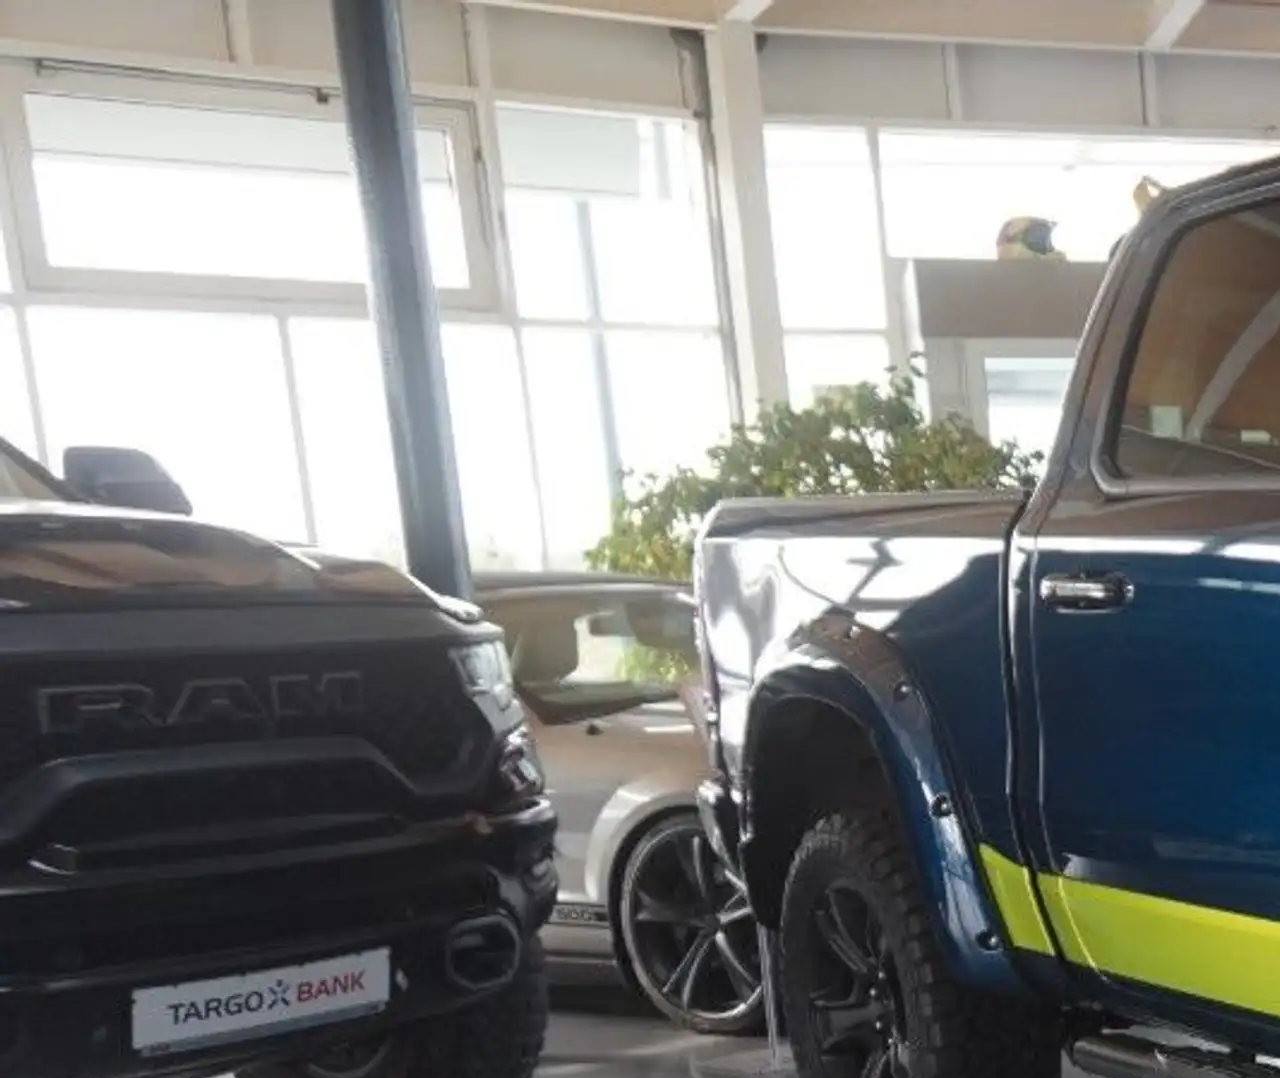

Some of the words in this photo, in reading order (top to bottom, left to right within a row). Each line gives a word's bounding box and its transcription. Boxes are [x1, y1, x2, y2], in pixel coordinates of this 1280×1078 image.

[37, 671, 363, 734] RAM
[168, 990, 264, 1026] TARGO
[296, 968, 367, 1003] BANK
